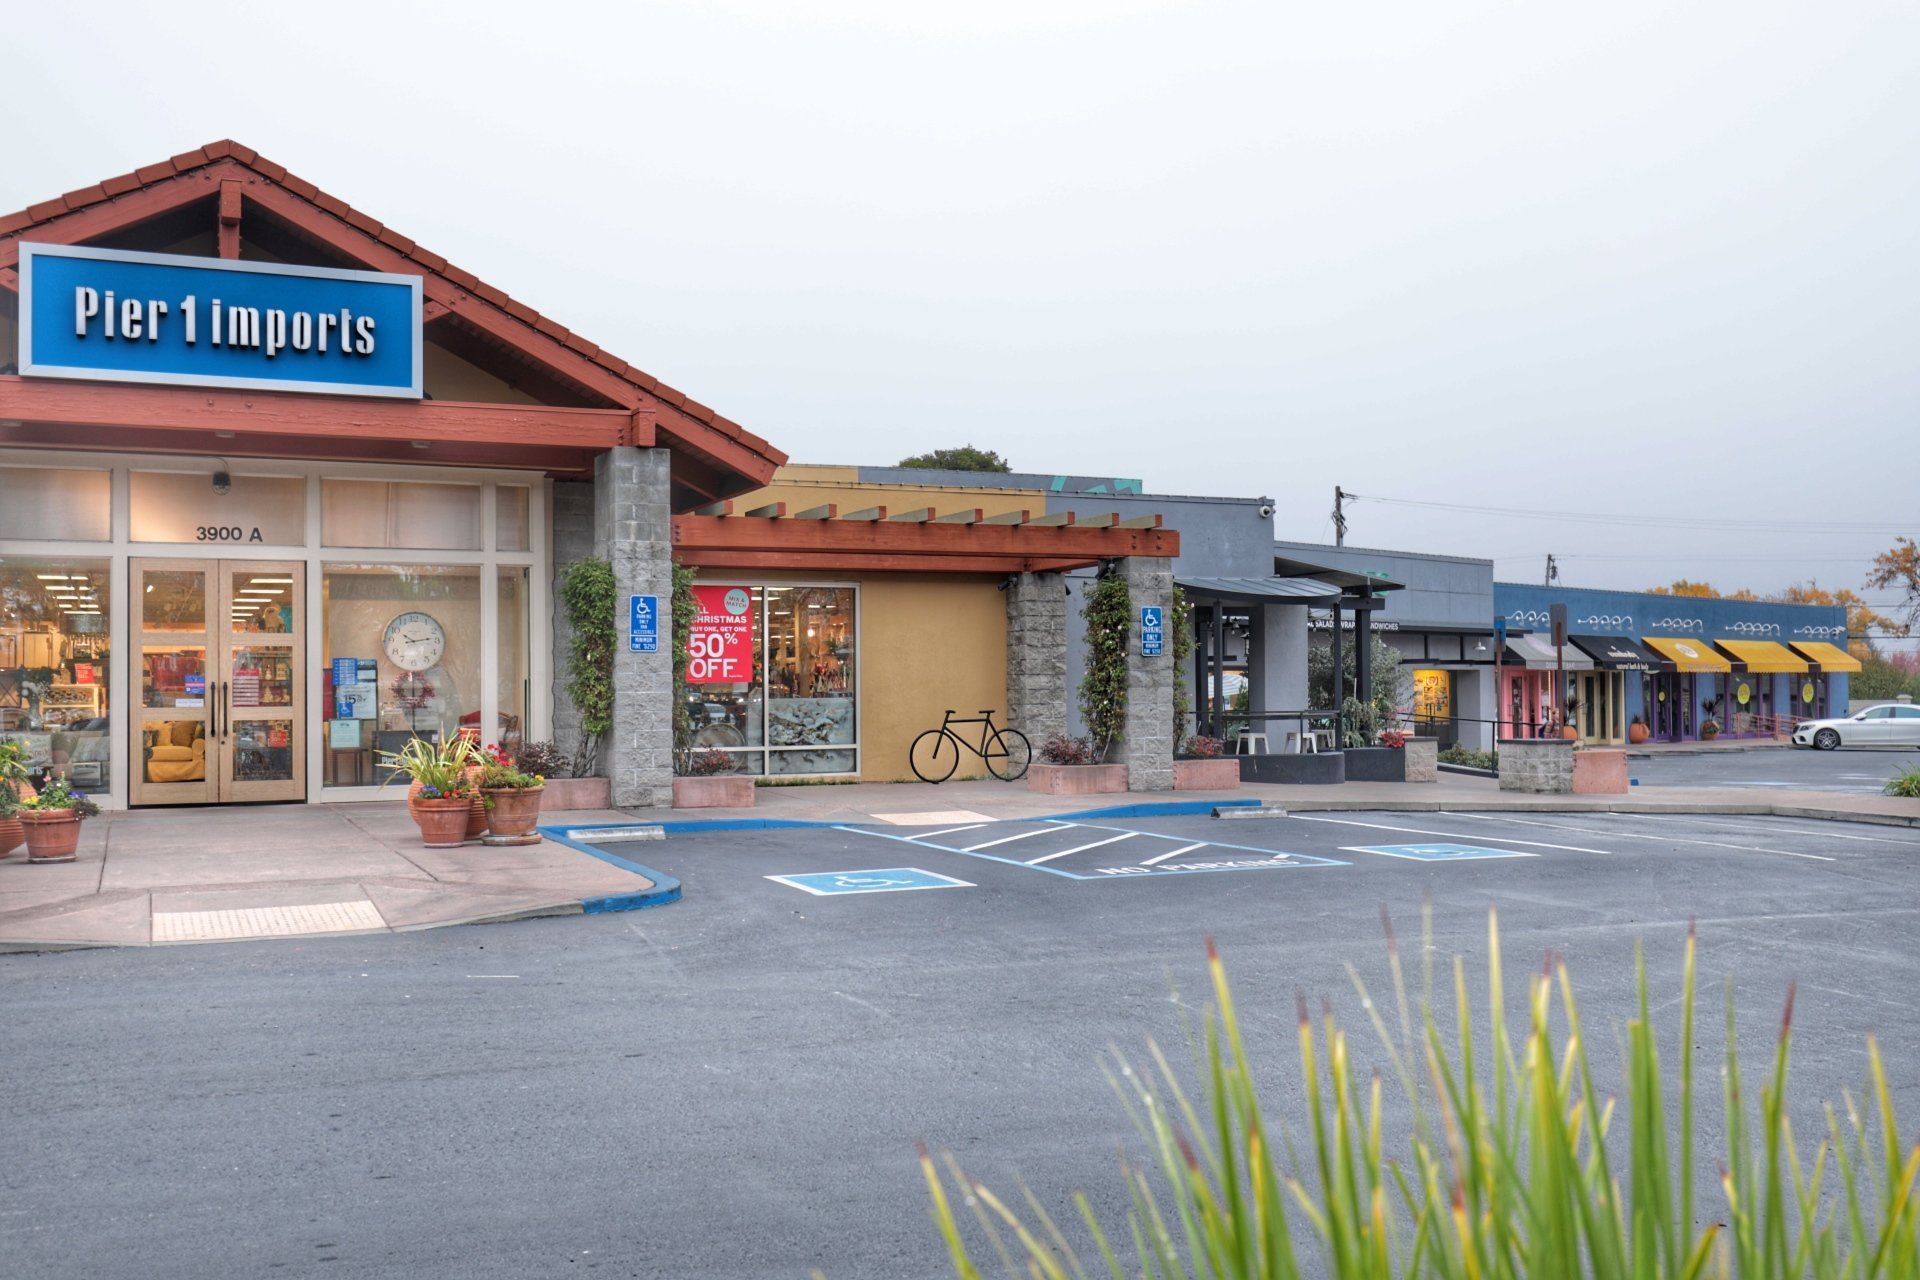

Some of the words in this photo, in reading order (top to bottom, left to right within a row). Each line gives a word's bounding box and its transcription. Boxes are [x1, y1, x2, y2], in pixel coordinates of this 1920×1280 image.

[75, 286, 168, 340] Pier
[180, 295, 196, 343] 1
[212, 298, 376, 356] imports
[196, 526, 242, 541] 3900
[249, 527, 263, 542] A
[726, 600, 747, 608] MATCH
[704, 626, 719, 634] ONE,
[1143, 626, 1161, 634] PARKING
[1146, 633, 1158, 641] ONLY
[689, 658, 738, 678] OFF
[1096, 866, 1151, 875] NO
[1157, 858, 1300, 871] PARKING
